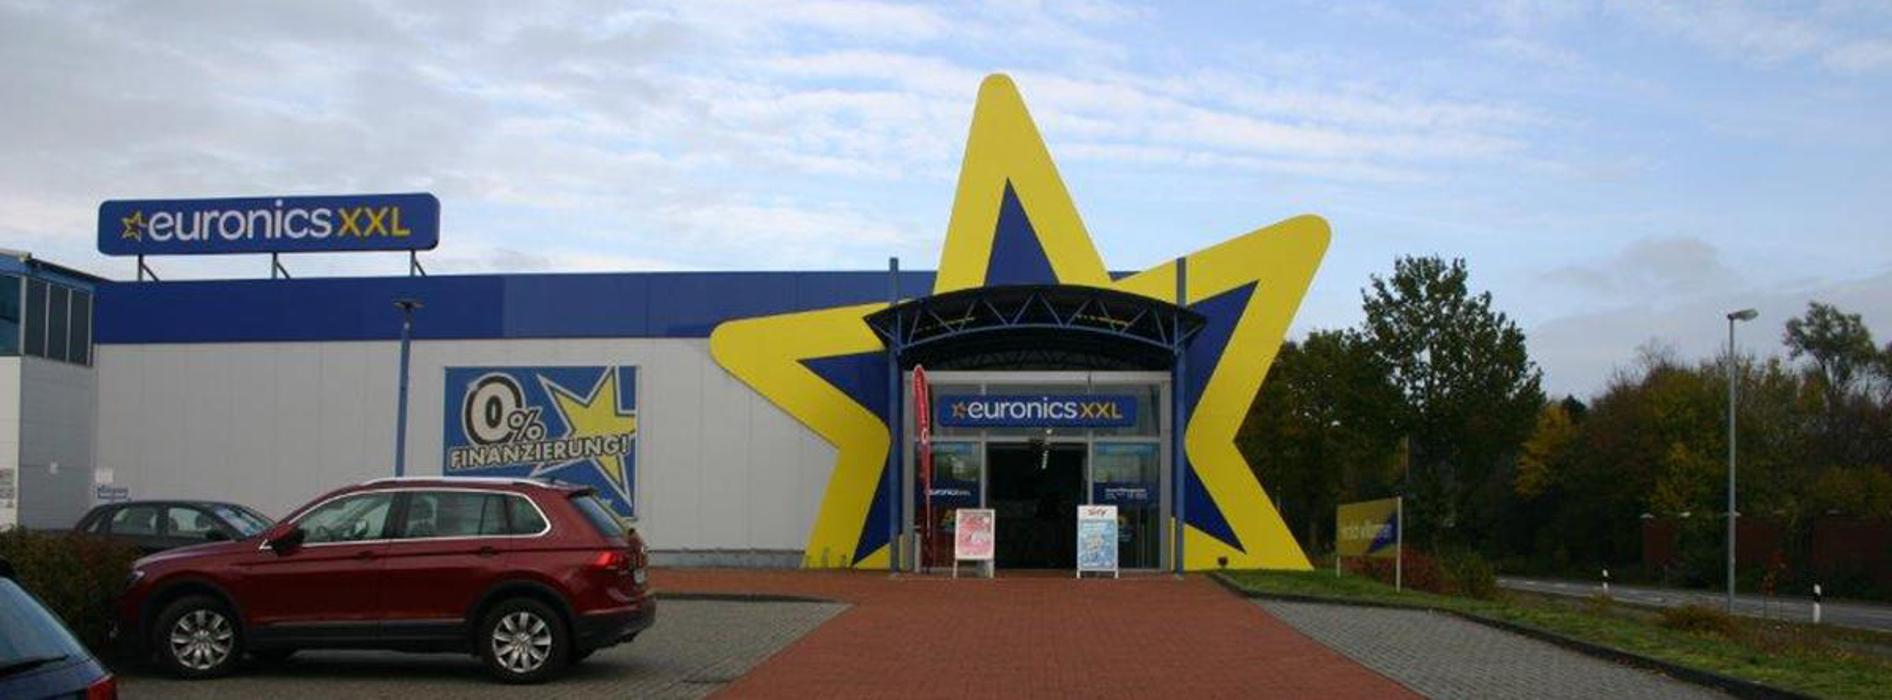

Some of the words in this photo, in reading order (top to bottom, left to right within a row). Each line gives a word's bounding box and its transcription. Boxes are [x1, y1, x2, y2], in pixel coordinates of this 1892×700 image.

[149, 199, 332, 242] euronics
[337, 207, 411, 237] XXL
[463, 374, 546, 446] 0%
[967, 397, 1078, 419] euronics
[1080, 402, 1123, 419] XXL
[450, 434, 629, 470] FINANZIERUNG!
